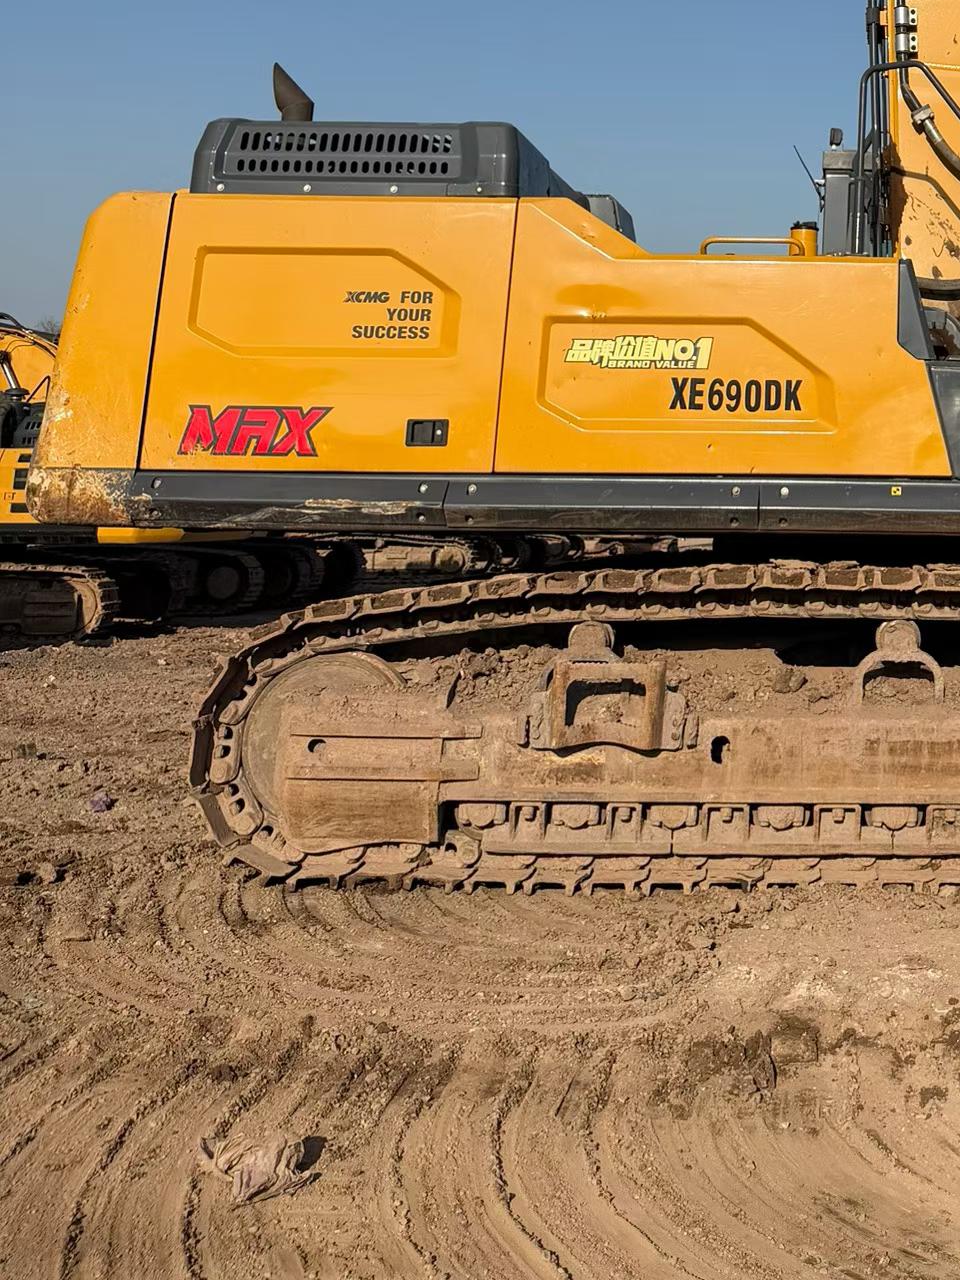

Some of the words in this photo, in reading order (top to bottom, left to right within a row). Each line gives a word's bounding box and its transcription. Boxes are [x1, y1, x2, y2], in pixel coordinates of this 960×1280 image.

[343, 291, 390, 303] XCMG
[400, 291, 433, 304] FOR
[387, 308, 432, 321] YOUR
[352, 325, 430, 339] SUCCESS
[608, 360, 650, 368] BRAND
[656, 360, 696, 369] VALUE
[669, 377, 803, 412] XE690DK
[177, 404, 335, 457] MAX
